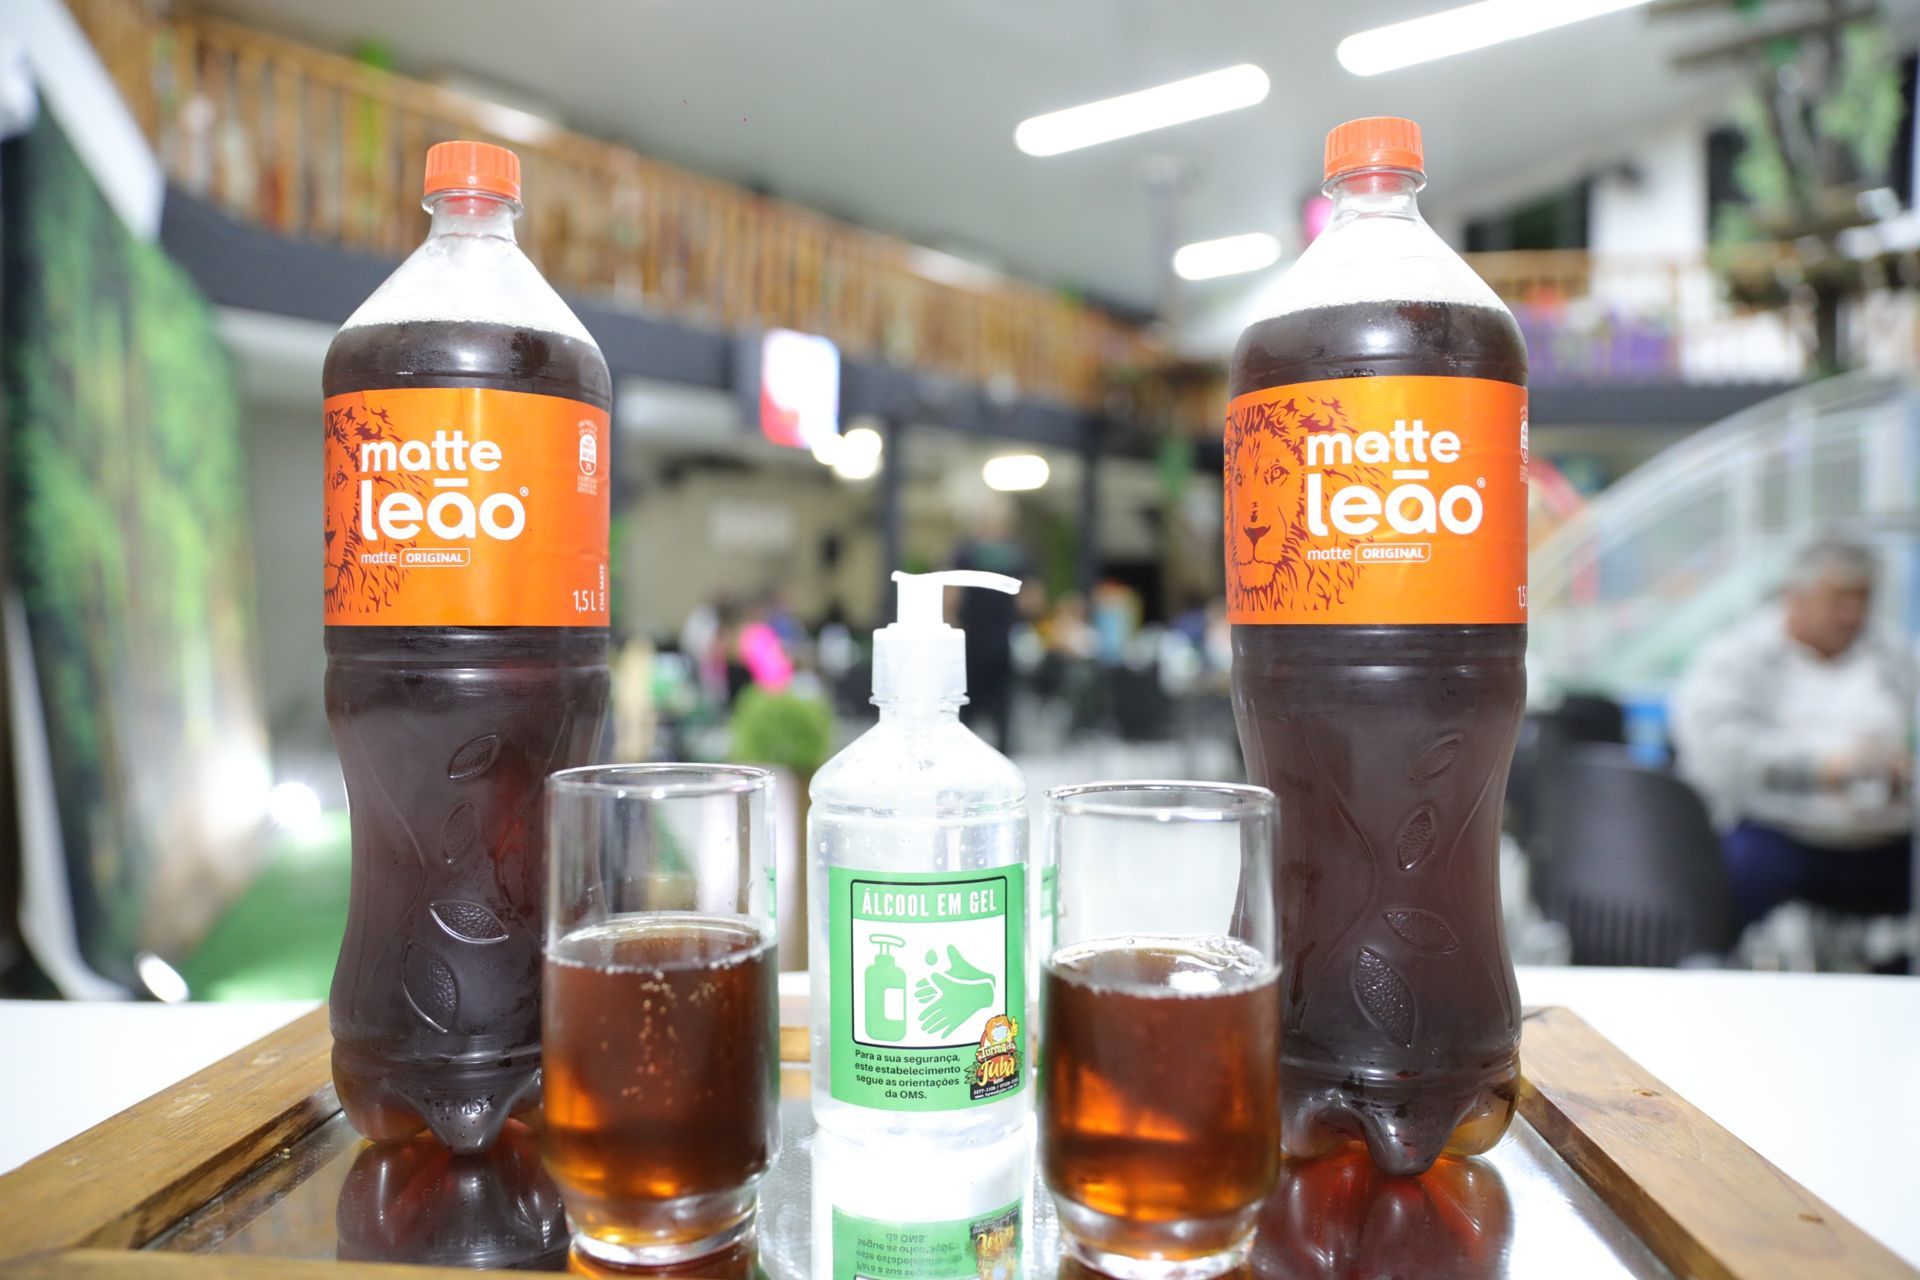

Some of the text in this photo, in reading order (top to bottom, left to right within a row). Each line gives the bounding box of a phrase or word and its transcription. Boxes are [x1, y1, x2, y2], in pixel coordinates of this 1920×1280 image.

[361, 430, 502, 472] matte
[1307, 420, 1461, 466] matte
[361, 552, 464, 564] matte ORIGINAL
[1307, 548, 1424, 560] matte ORIGINAL
[572, 590, 589, 614] 1,5
[862, 888, 997, 917] ÁLCOOL EM GEL
[855, 1049, 961, 1066] Para a sua segurança,
[978, 1043, 1007, 1059] Turma
[855, 1062, 961, 1076] este estabelecimento
[978, 1055, 1016, 1087] Juba
[856, 1074, 960, 1088] segue as orientações
[884, 1089, 928, 1100] da OMS.
